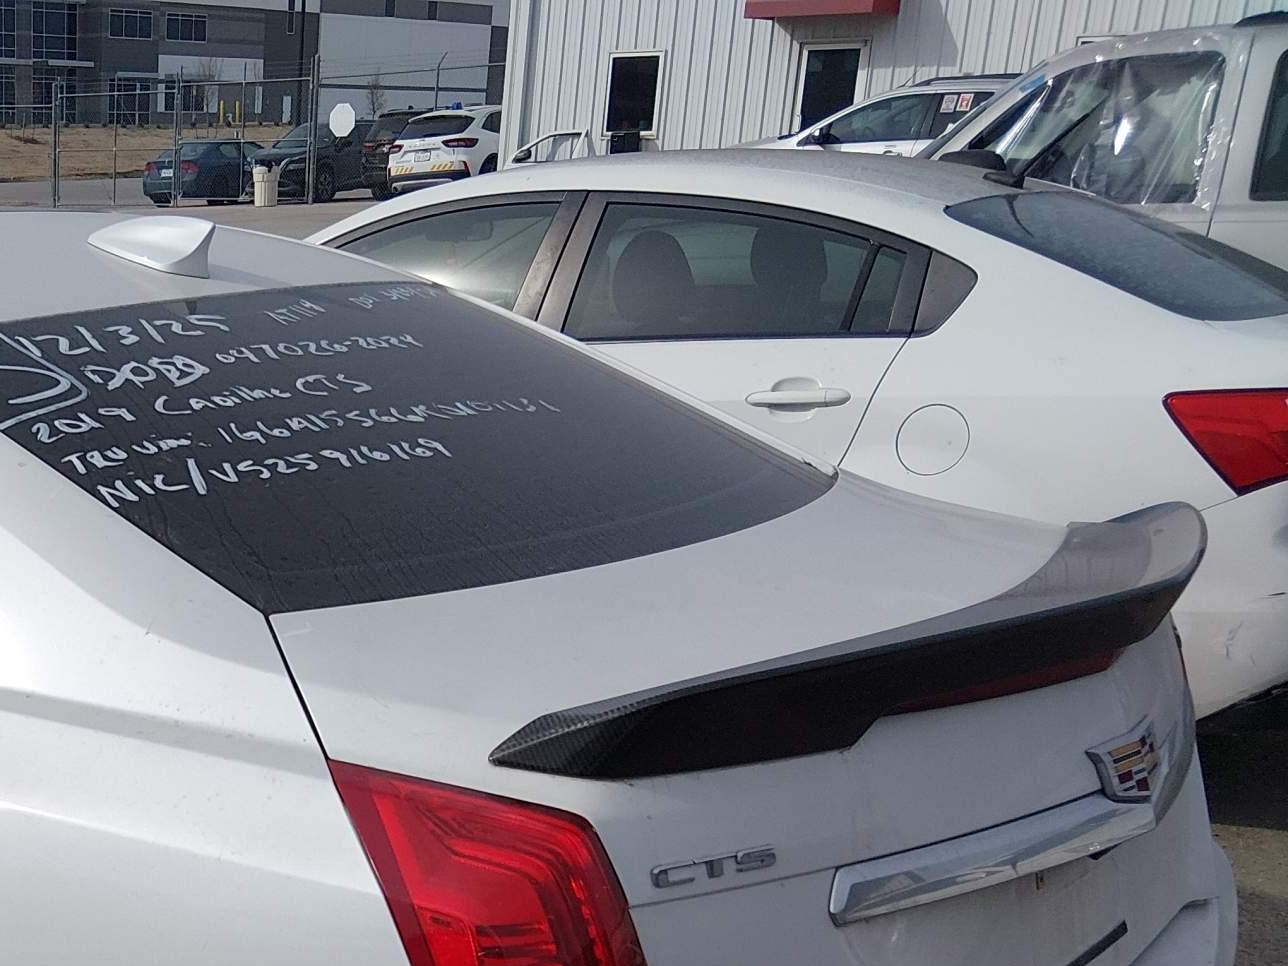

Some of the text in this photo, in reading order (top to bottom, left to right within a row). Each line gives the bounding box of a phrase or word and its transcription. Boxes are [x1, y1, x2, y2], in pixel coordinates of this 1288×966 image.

[31, 407, 137, 444] 2019
[295, 373, 373, 397] CTS
[650, 844, 778, 889] CTS
